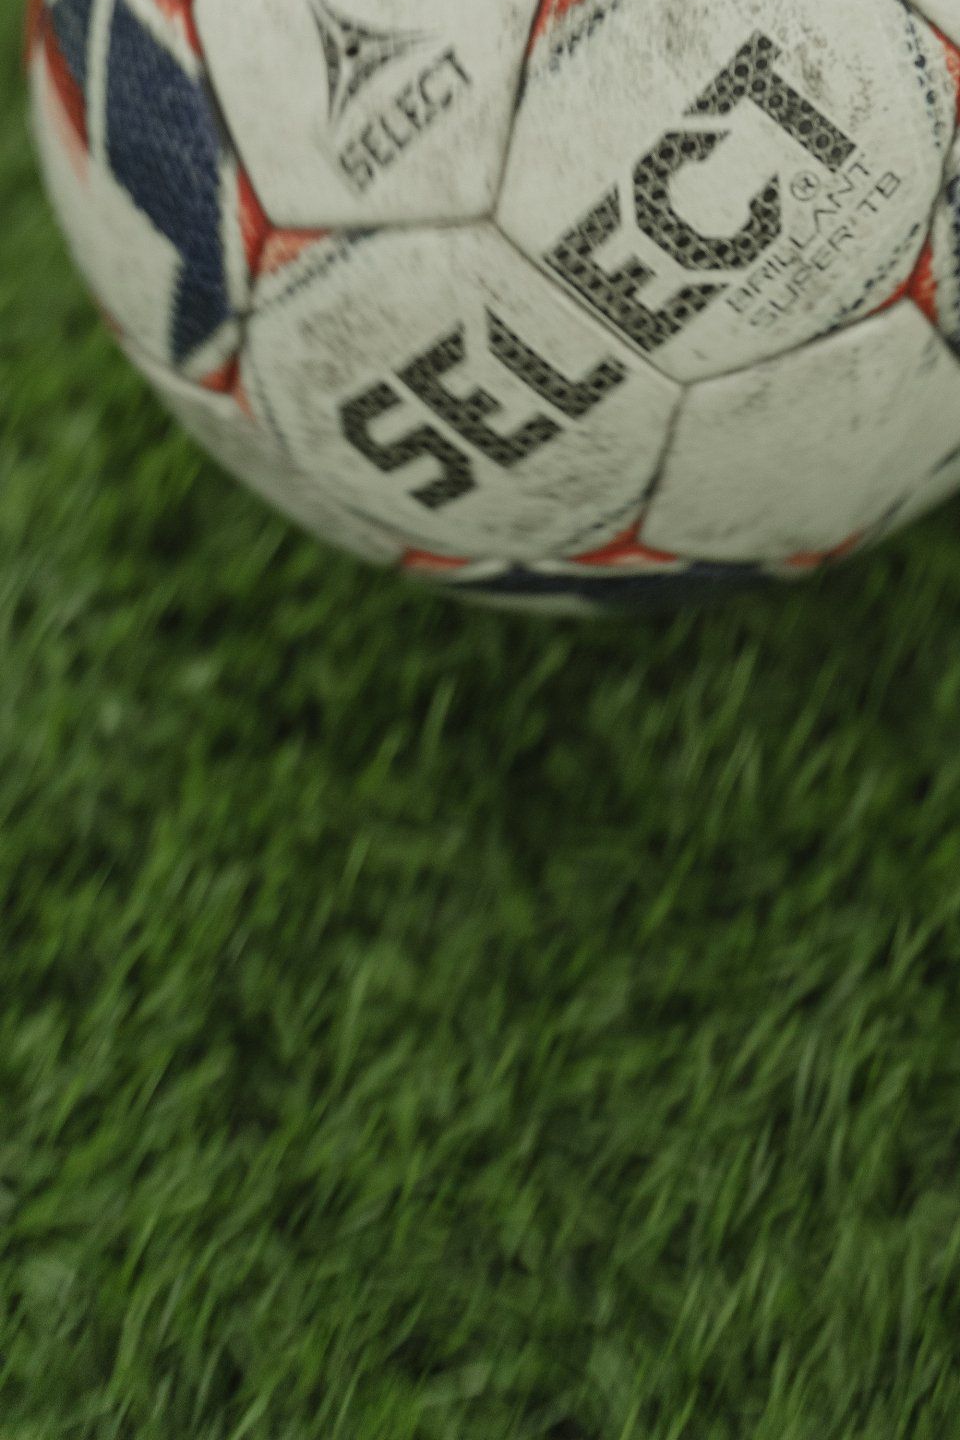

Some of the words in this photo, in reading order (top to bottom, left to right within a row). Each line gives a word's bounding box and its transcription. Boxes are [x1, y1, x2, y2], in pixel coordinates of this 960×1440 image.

[338, 43, 474, 194] SELECT
[725, 153, 871, 314] BRILLANT
[749, 226, 855, 328] SUPER
